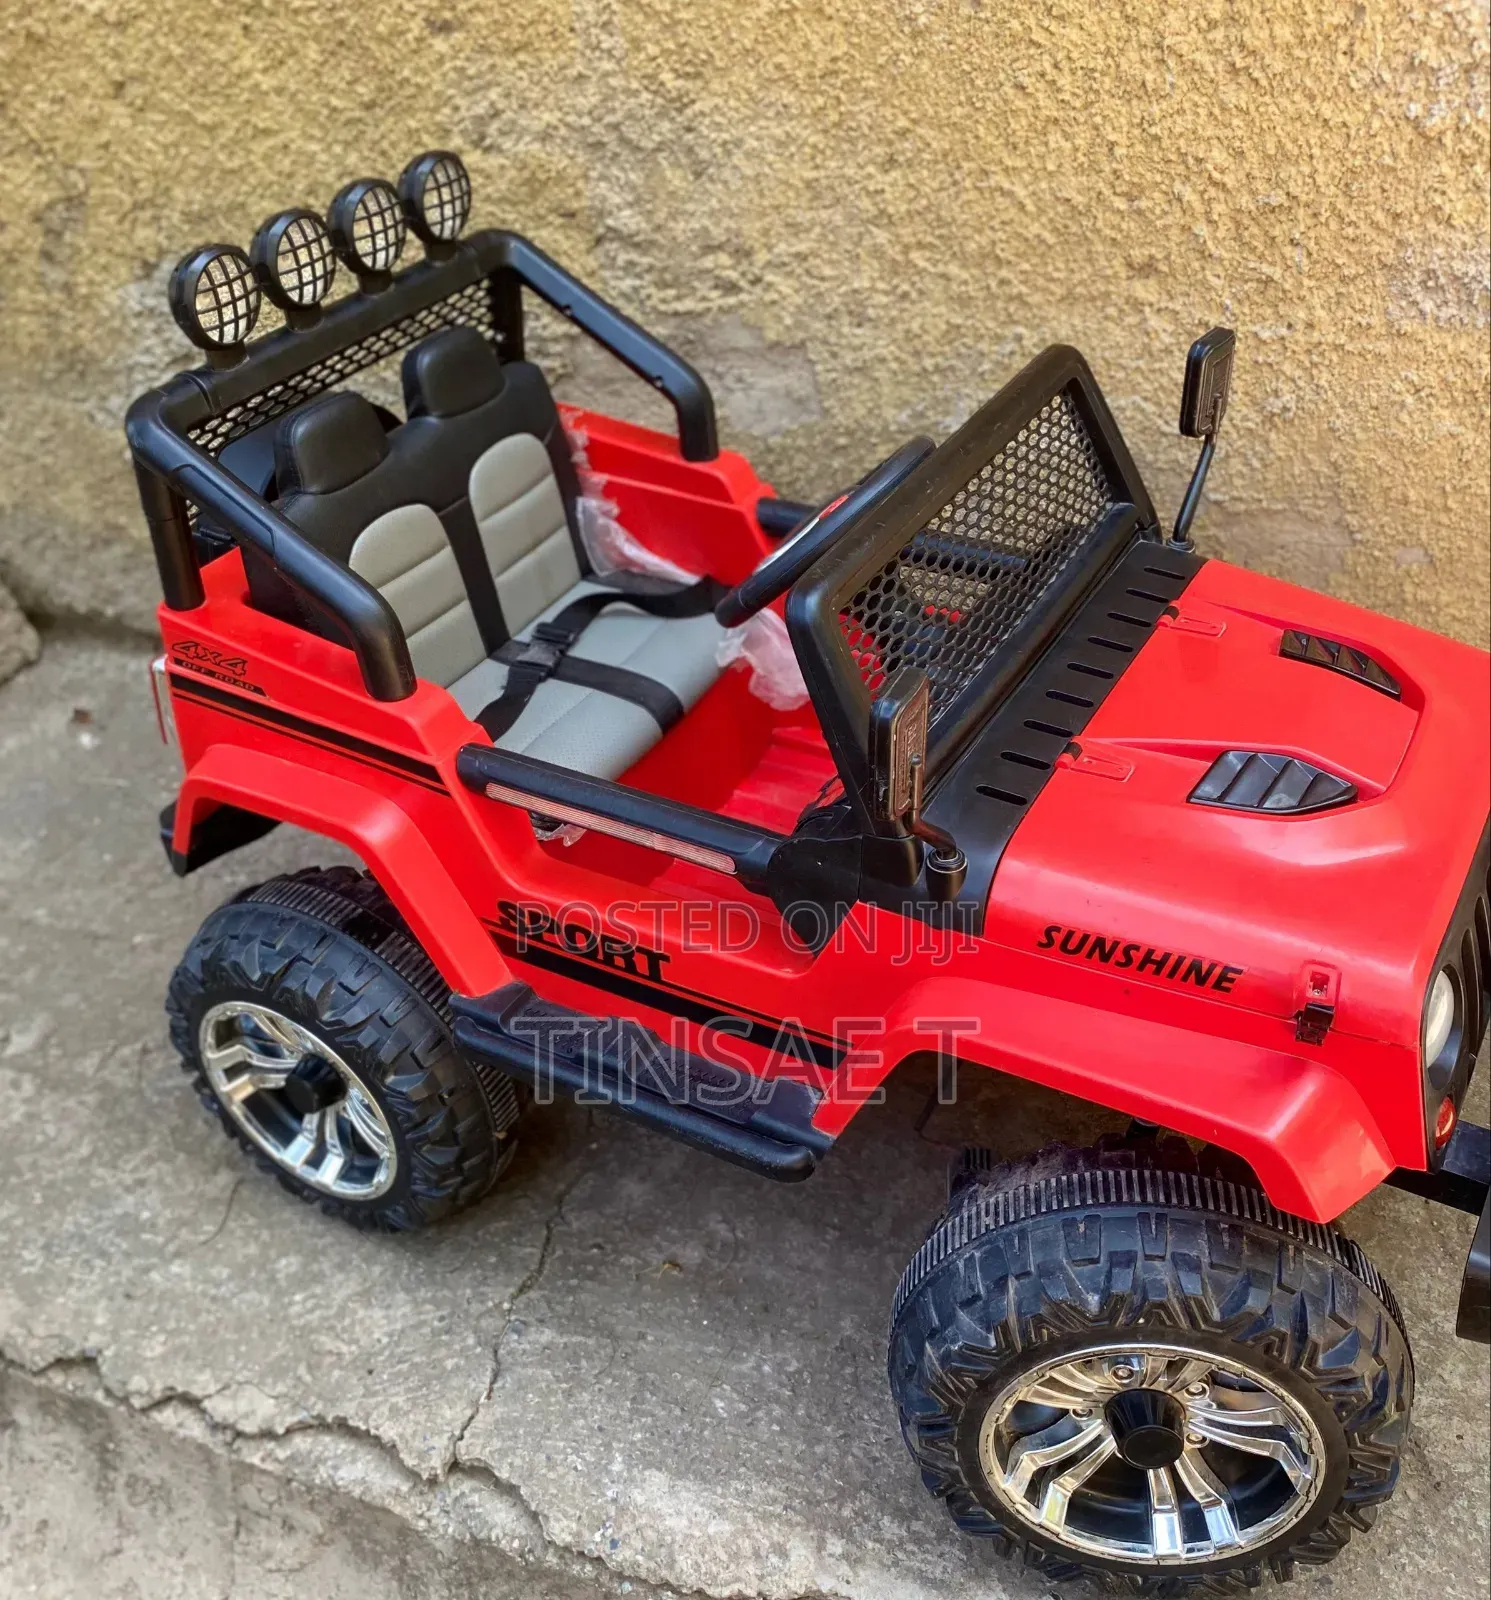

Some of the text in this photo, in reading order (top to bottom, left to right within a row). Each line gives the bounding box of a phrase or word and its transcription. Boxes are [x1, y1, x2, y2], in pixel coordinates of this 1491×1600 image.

[214, 672, 255, 691] ROAD
[497, 897, 671, 981] SPORT
[1036, 924, 1244, 994] SUNSHINE
